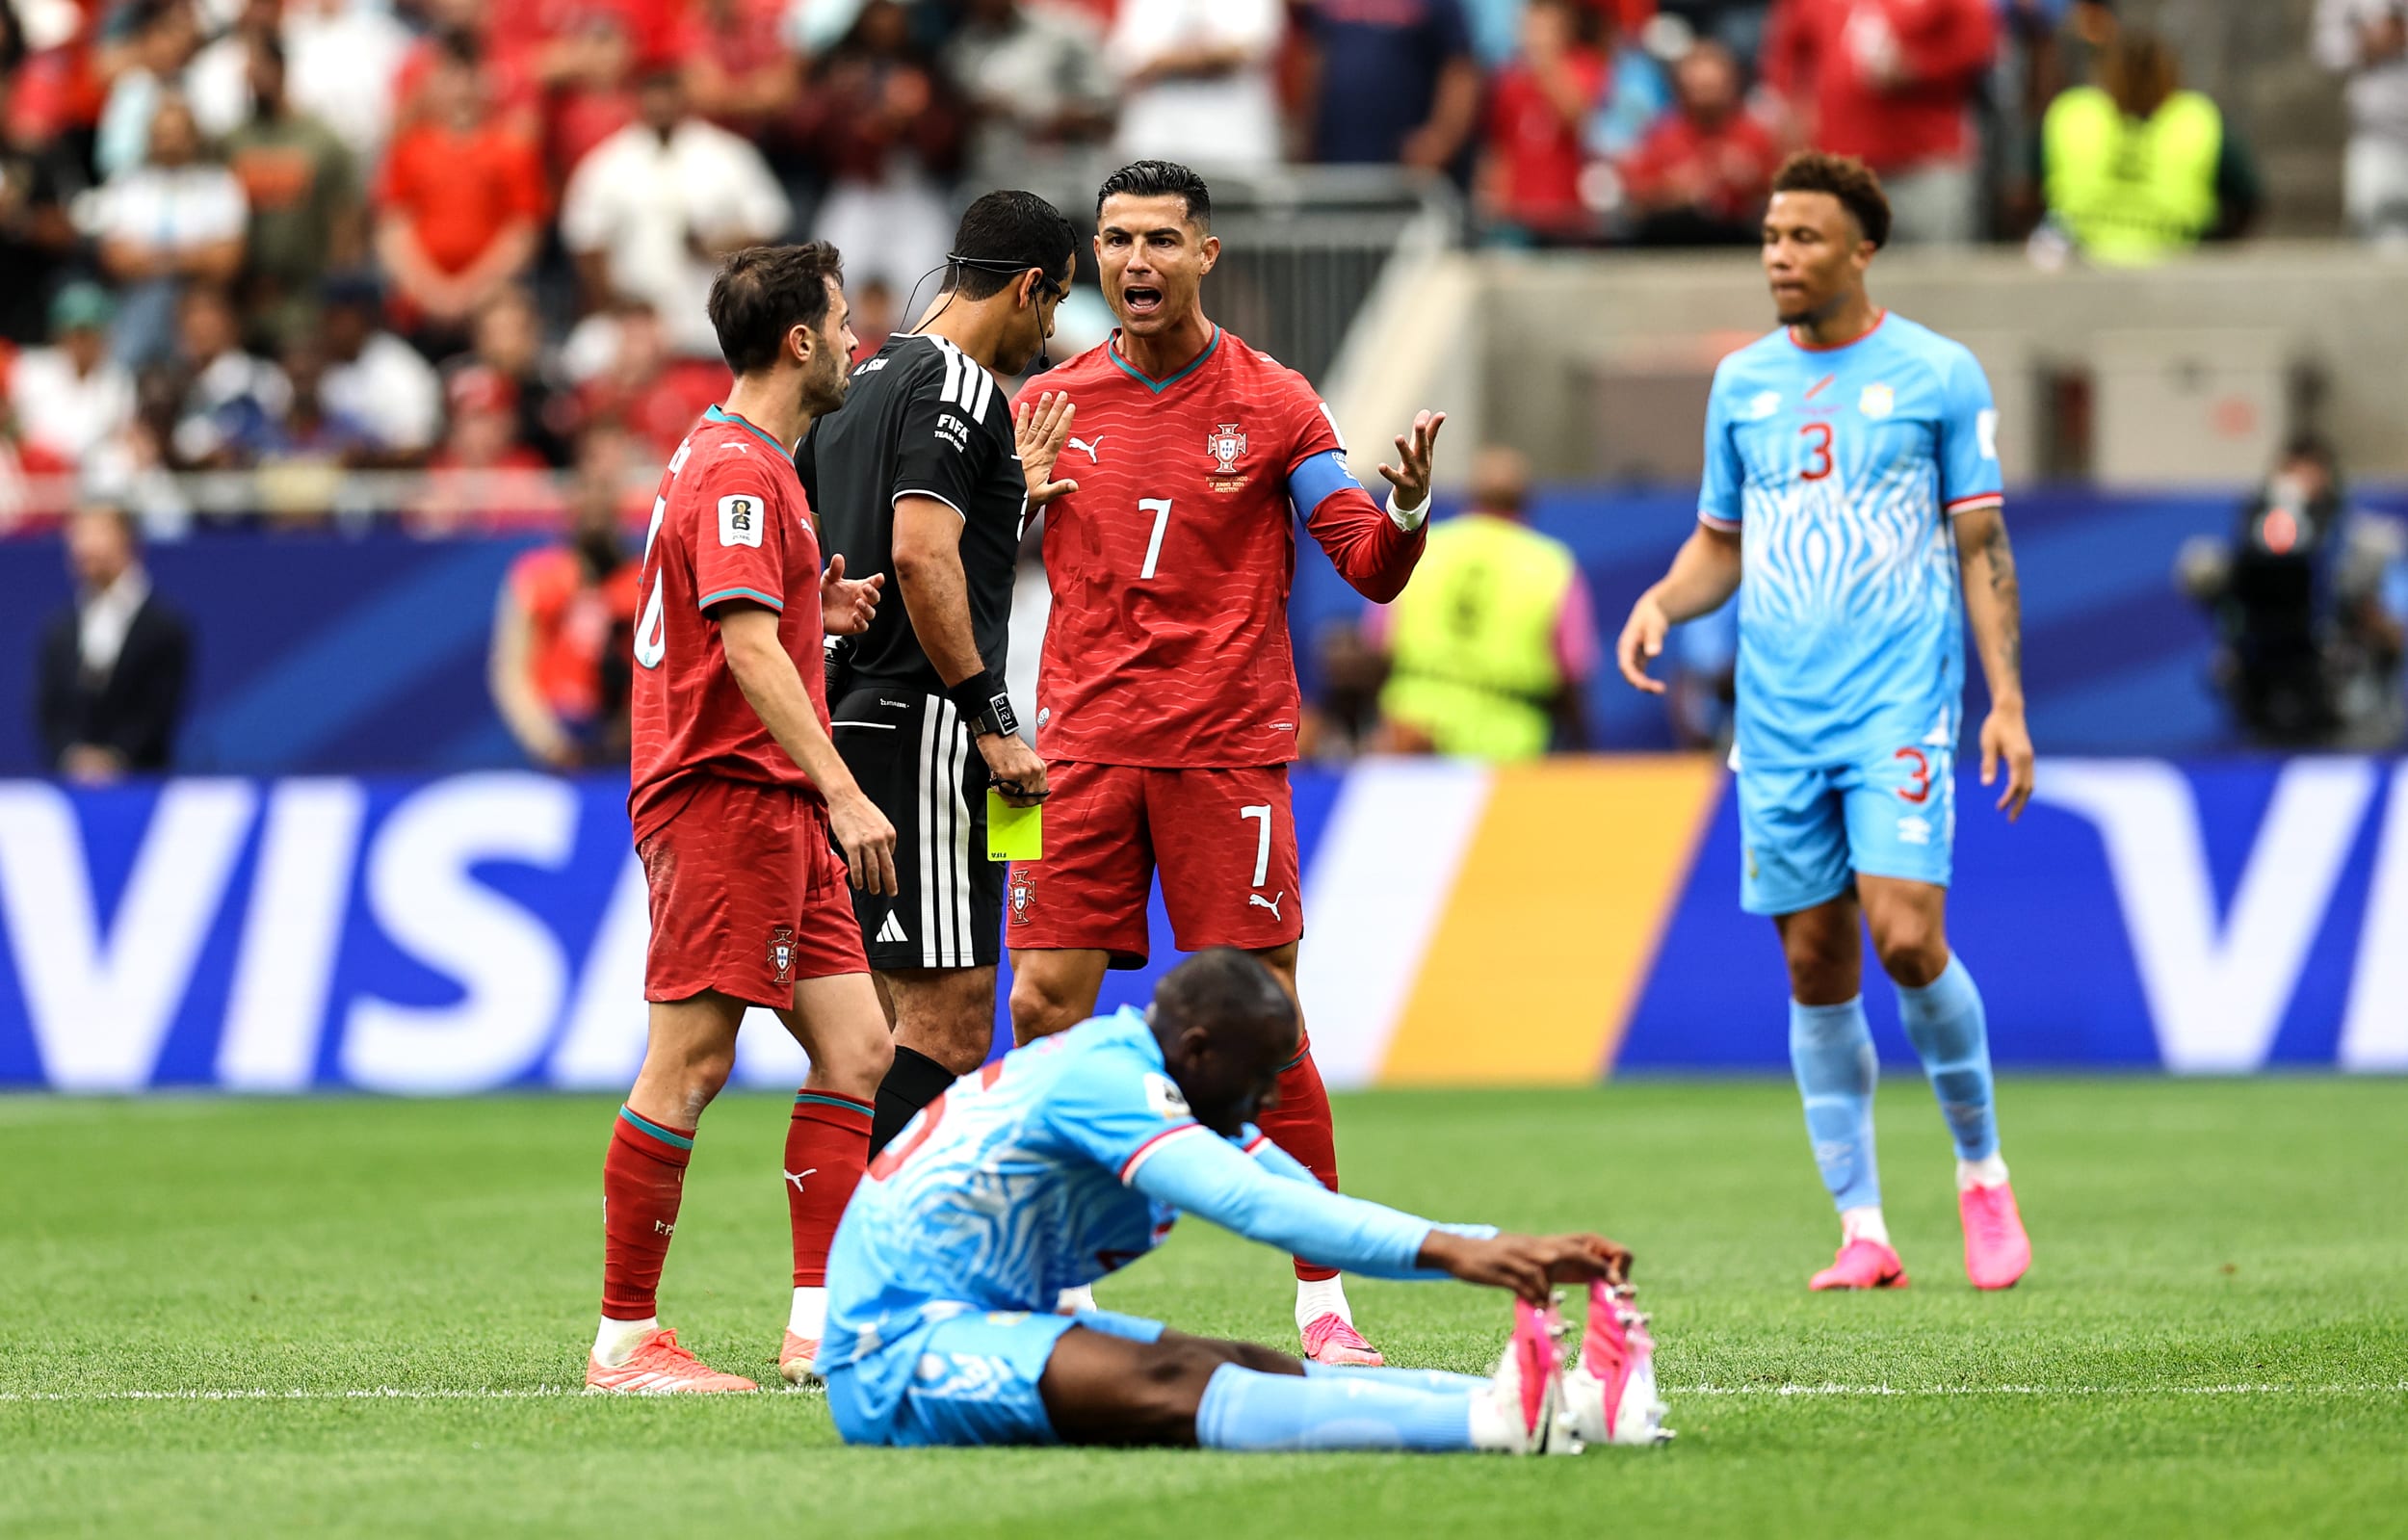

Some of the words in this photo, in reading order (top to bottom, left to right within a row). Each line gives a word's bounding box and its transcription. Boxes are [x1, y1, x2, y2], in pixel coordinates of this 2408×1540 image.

[934, 431, 955, 443] TEAM
[936, 414, 970, 444] FIFA
[1799, 422, 1834, 482] 3
[1138, 497, 1173, 580] 7
[1895, 746, 1931, 804] 3
[1240, 804, 1271, 887] 7
